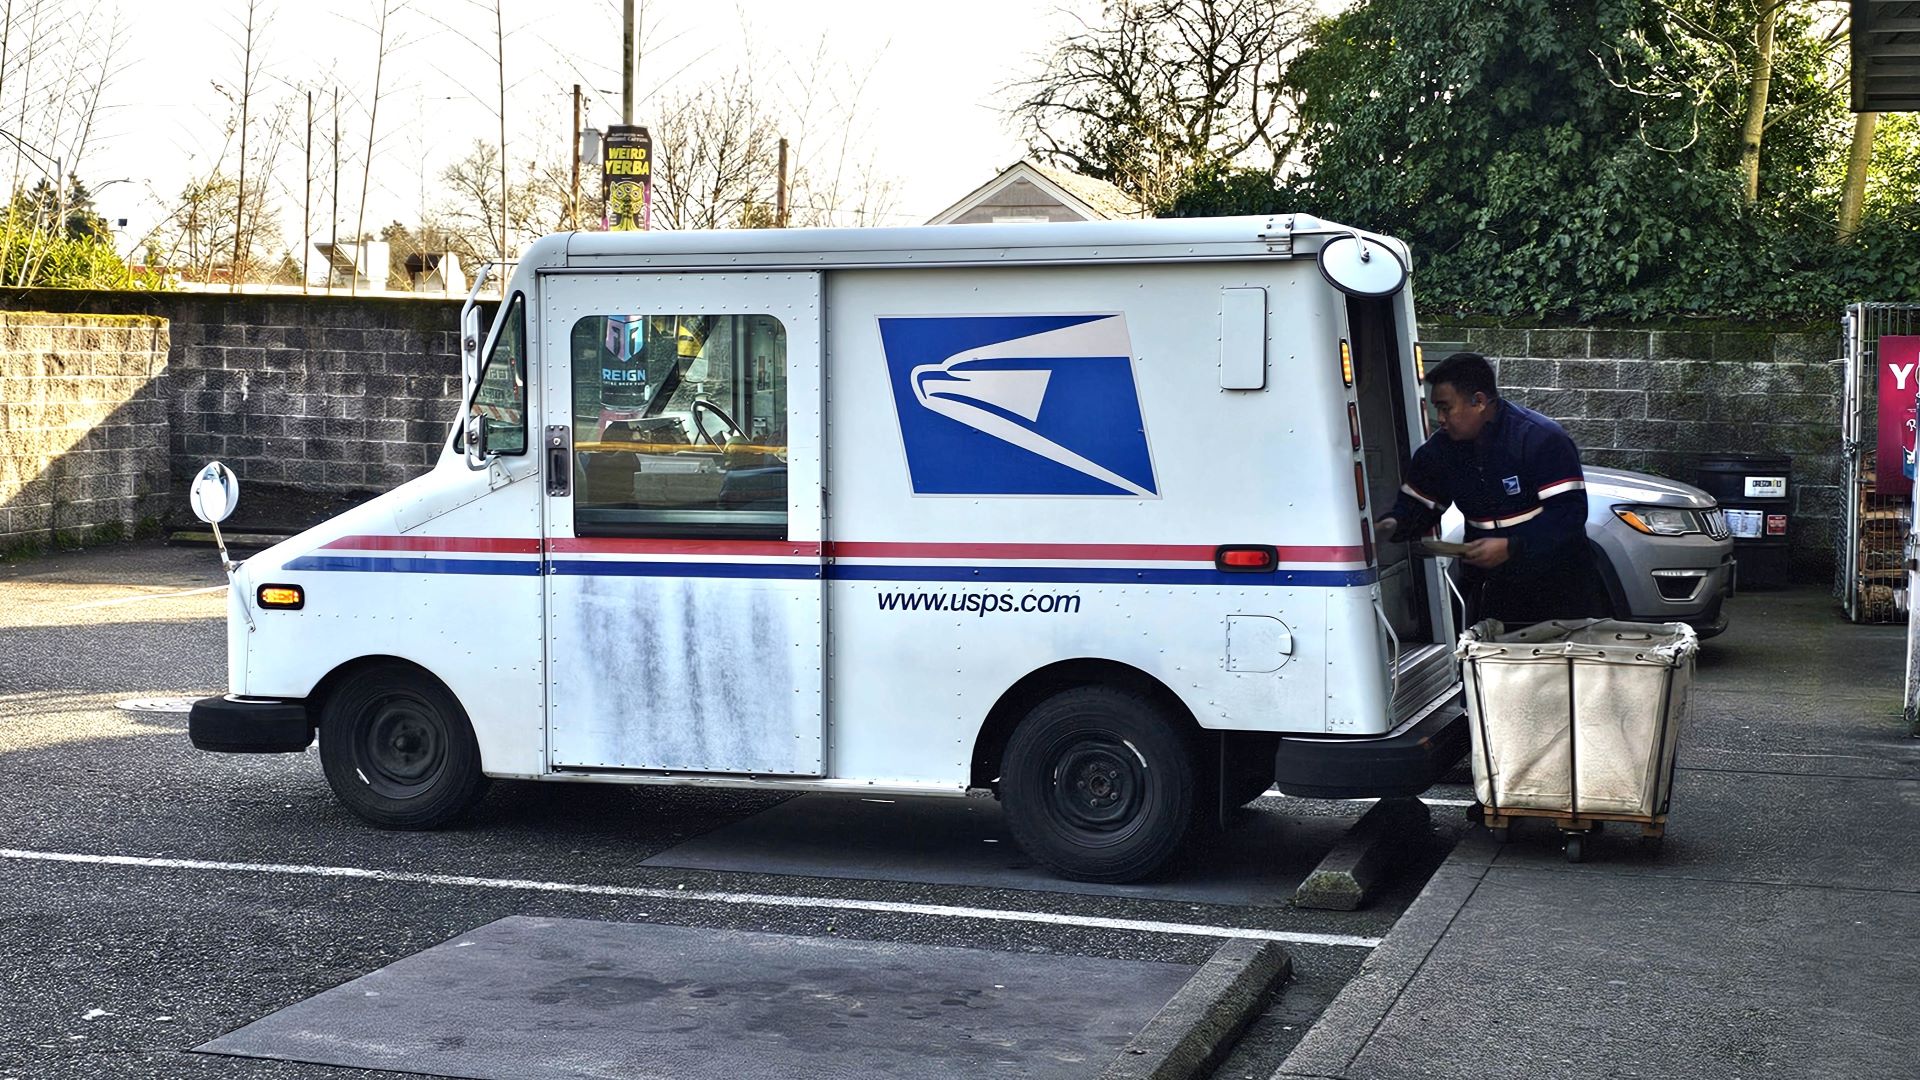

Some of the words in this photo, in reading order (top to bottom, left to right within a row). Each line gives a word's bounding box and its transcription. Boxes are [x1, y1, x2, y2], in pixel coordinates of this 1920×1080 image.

[608, 147, 646, 160] WEIRD
[605, 160, 649, 175] YERBA
[602, 368, 646, 381] REIGN
[1888, 363, 1920, 390] Y
[877, 592, 1081, 618] www.usps.com
